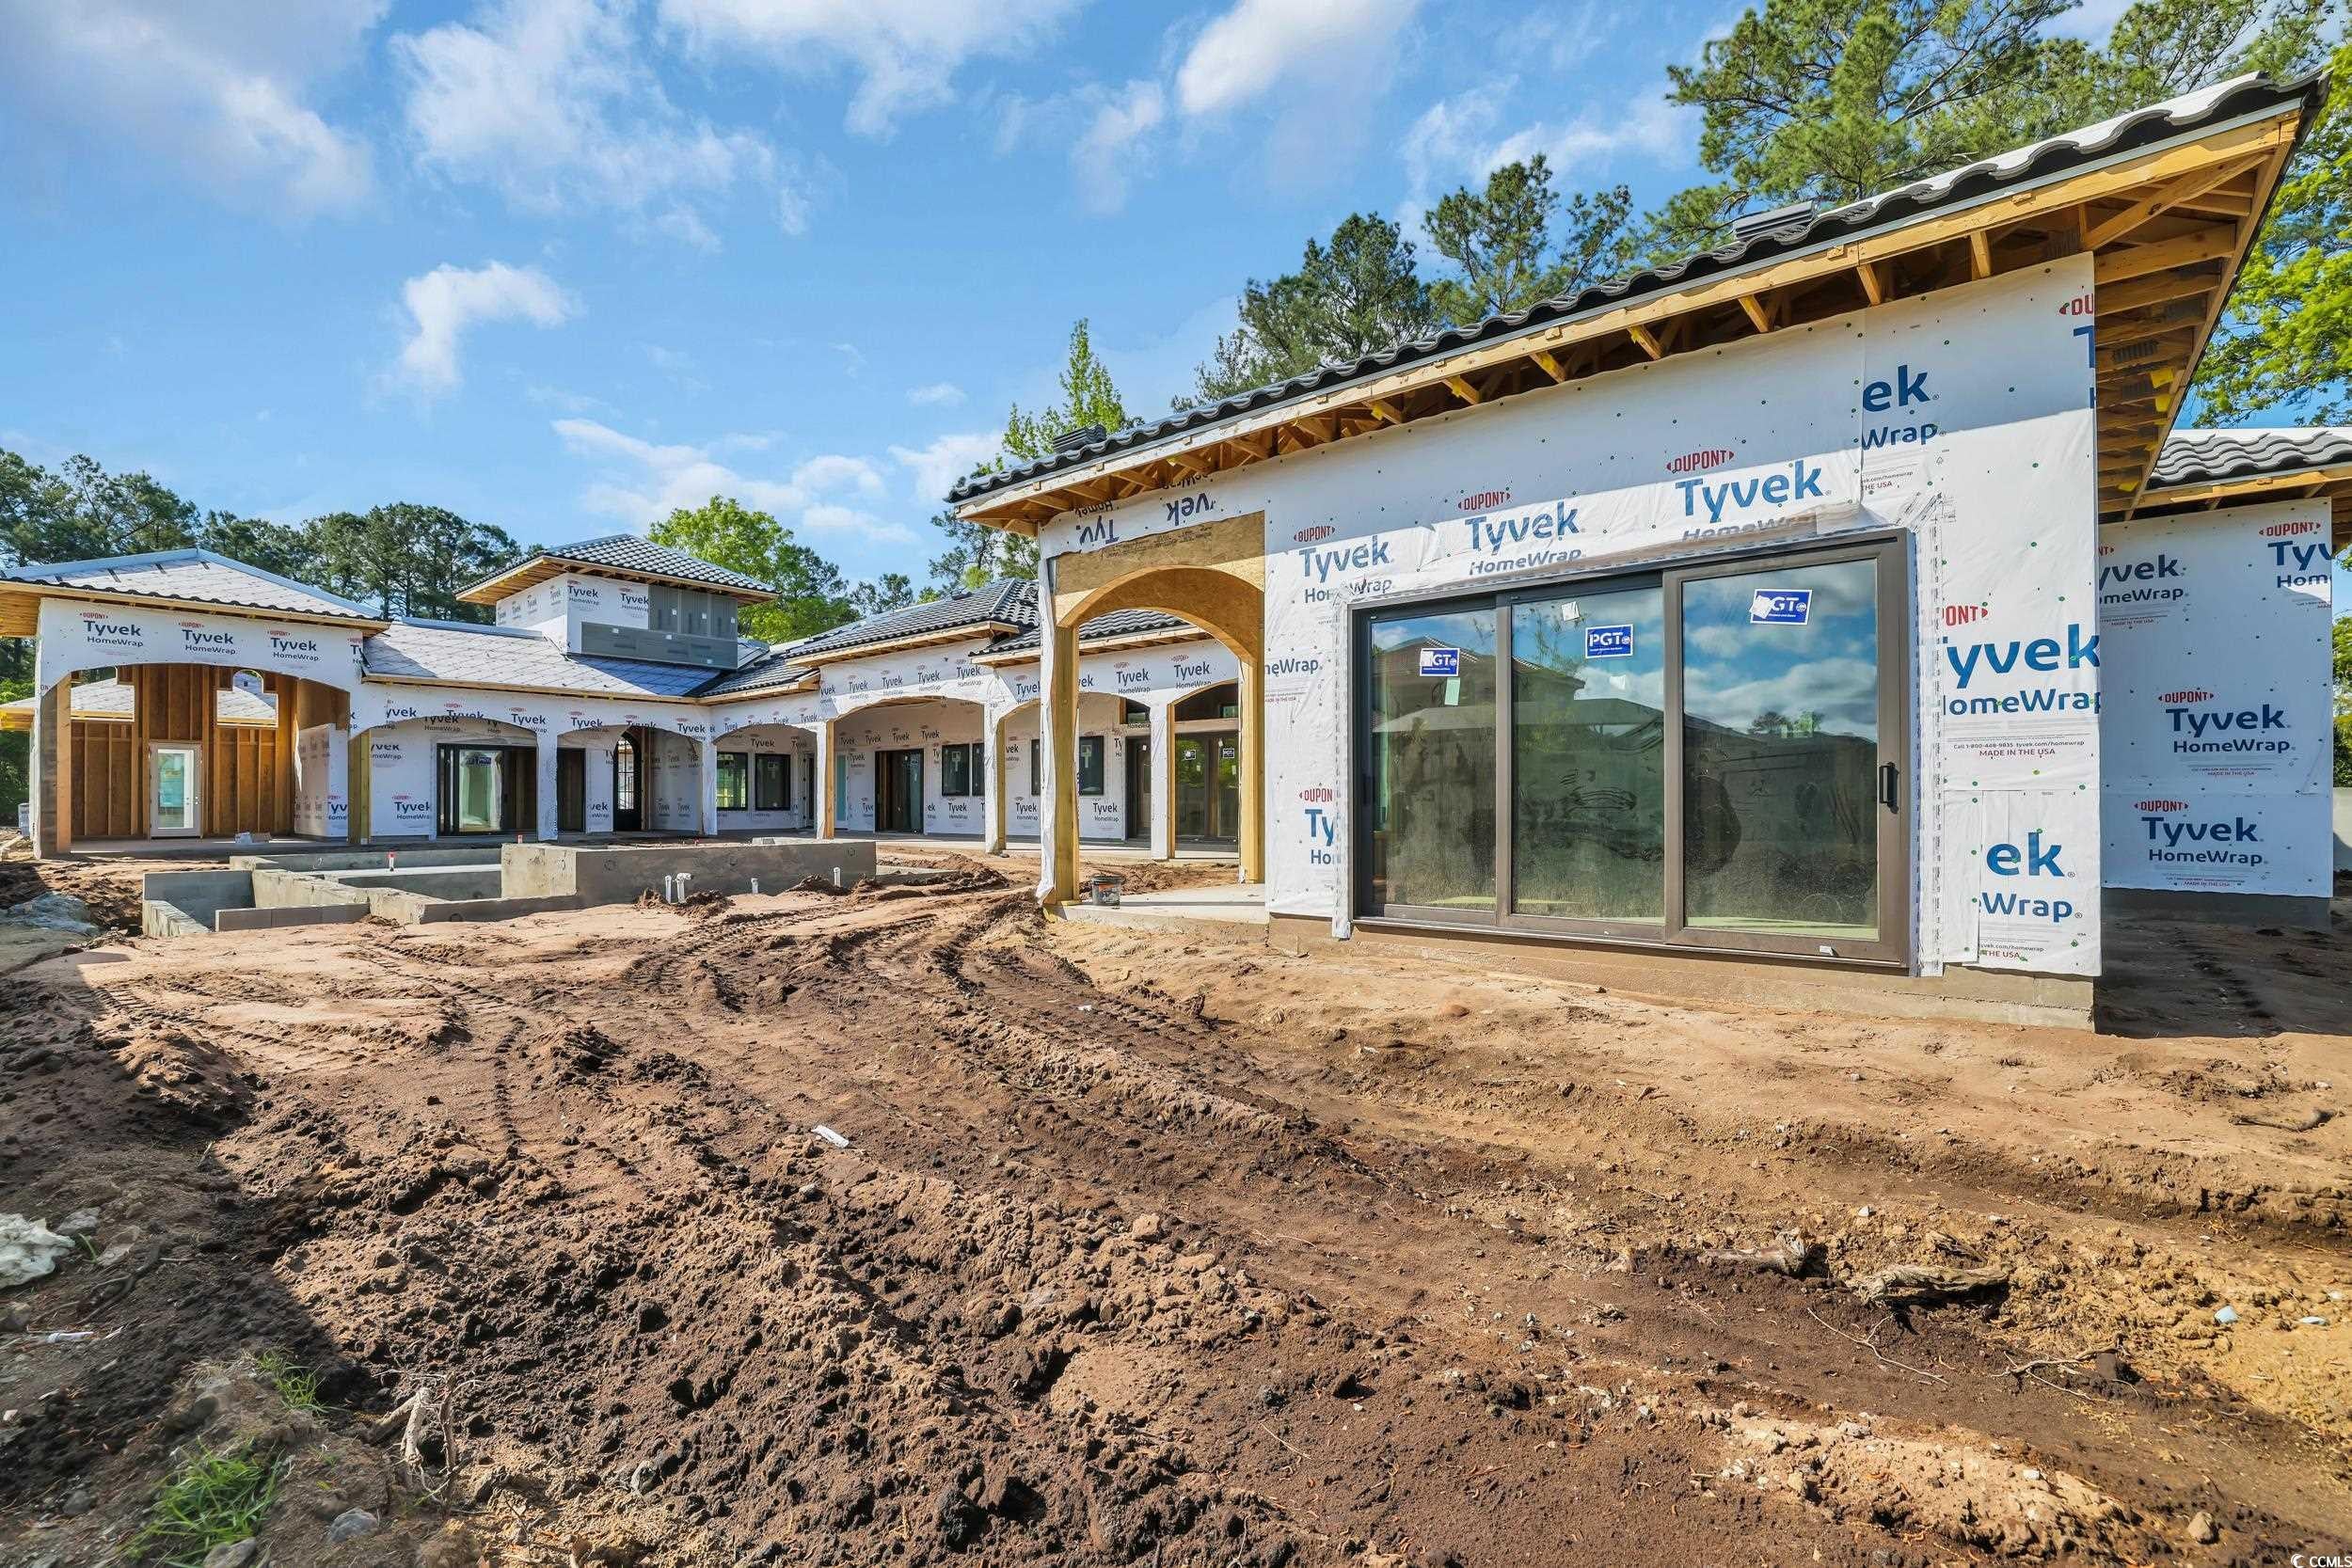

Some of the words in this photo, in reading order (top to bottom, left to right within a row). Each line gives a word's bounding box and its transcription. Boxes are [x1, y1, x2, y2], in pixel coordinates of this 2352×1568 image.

[1673, 450, 1726, 472] DUPONT
[1676, 459, 1823, 523] Tyvek
[1464, 492, 1504, 511] DUPONT
[1297, 526, 1331, 543] DUPONT
[1465, 500, 1580, 556] Tyvek
[2266, 522, 2314, 536] DUPONT
[1298, 535, 1390, 583] Tyvek
[1469, 547, 1581, 576] HomeWrap
[567, 585, 598, 598] Tyvek
[83, 620, 142, 637] Tyvek
[87, 636, 144, 648] HomeWrap
[182, 629, 234, 645] Tyvek
[1589, 632, 1624, 647] PGT
[184, 644, 236, 656] HomeWrap
[270, 637, 317, 653] Tyvek
[273, 652, 319, 662] HomeWrap
[956, 665, 981, 679] Tyvek
[1174, 661, 1210, 678] Tyvek
[882, 676, 903, 689] Tyvek
[917, 671, 941, 684] Tyvek
[1117, 669, 1149, 685] Tyvek
[849, 680, 868, 693] Tyvek
[1118, 686, 1151, 694] HomeWrap
[2165, 691, 2208, 704] DUPONT
[511, 713, 547, 725] Tyvek
[571, 717, 603, 729] Tyvek
[800, 713, 818, 723] Tyvek
[2166, 704, 2285, 738] Tyvek
[677, 722, 706, 734] Tyvek
[921, 729, 940, 739] Tyvek
[752, 738, 775, 750] Tyvek
[839, 736, 856, 746] Tyvek
[865, 734, 882, 744] Tyvek
[892, 732, 910, 743] Tyvek
[2174, 738, 2290, 753] HomeWrap
[850, 752, 866, 763] Tyvek
[948, 802, 967, 814] Tyvek
[1016, 802, 1038, 814] Tyvek
[1093, 802, 1118, 814] Tyvek
[2141, 800, 2184, 812] DUPONT
[2141, 816, 2258, 847] Tyvek
[2149, 848, 2263, 867] HomeWrap
